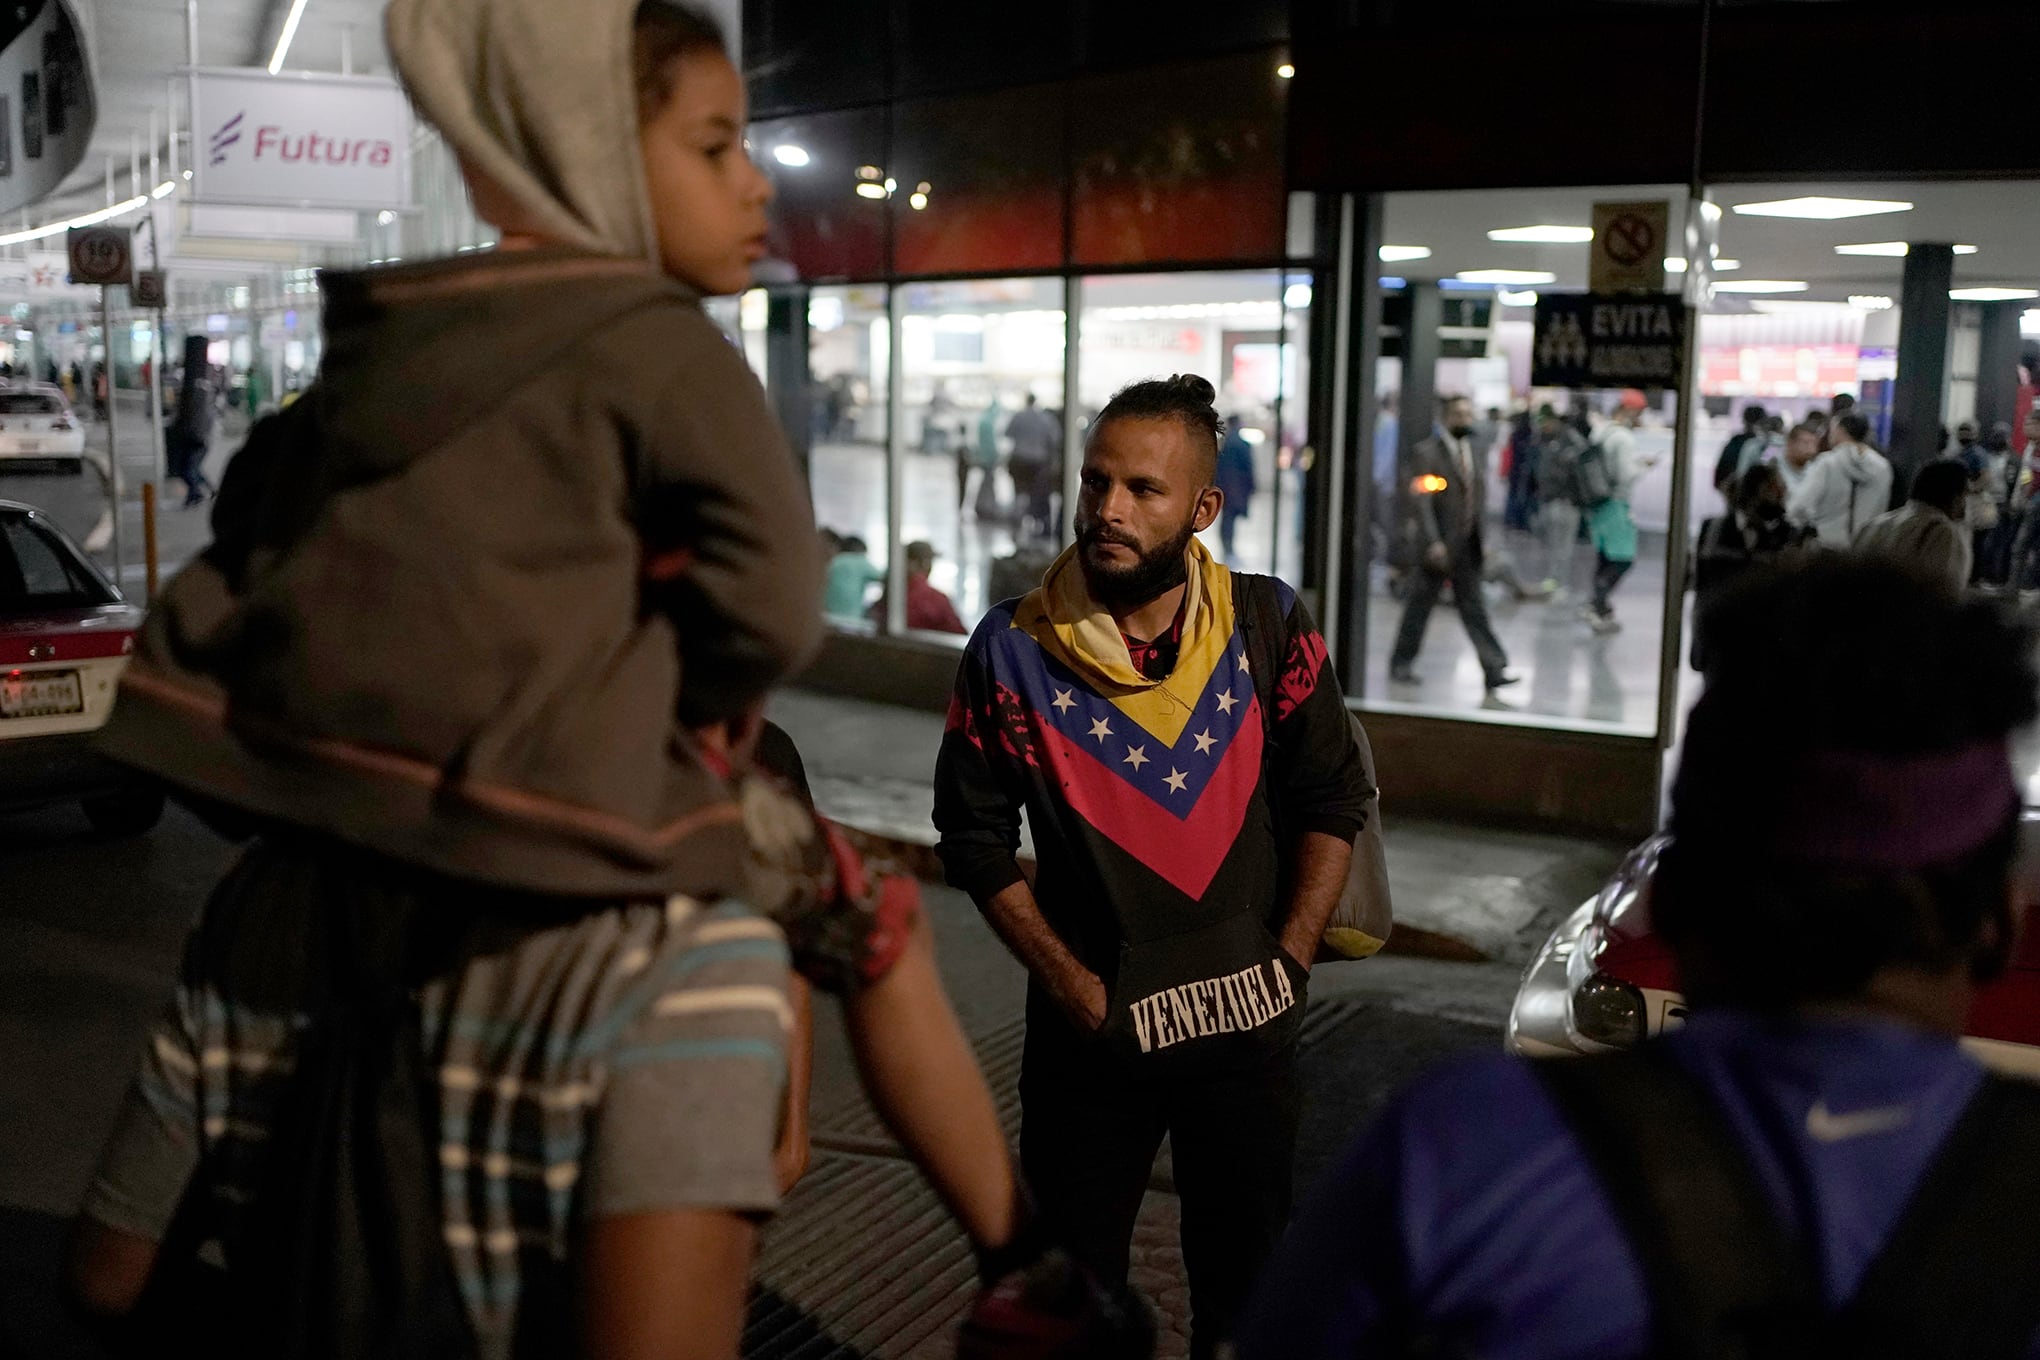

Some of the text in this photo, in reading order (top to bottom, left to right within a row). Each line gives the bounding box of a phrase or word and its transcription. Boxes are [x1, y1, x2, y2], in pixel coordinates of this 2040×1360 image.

[254, 126, 392, 166] Futura
[1592, 304, 1672, 336] EVITA
[1129, 958, 1296, 1053] VENEZUELA
